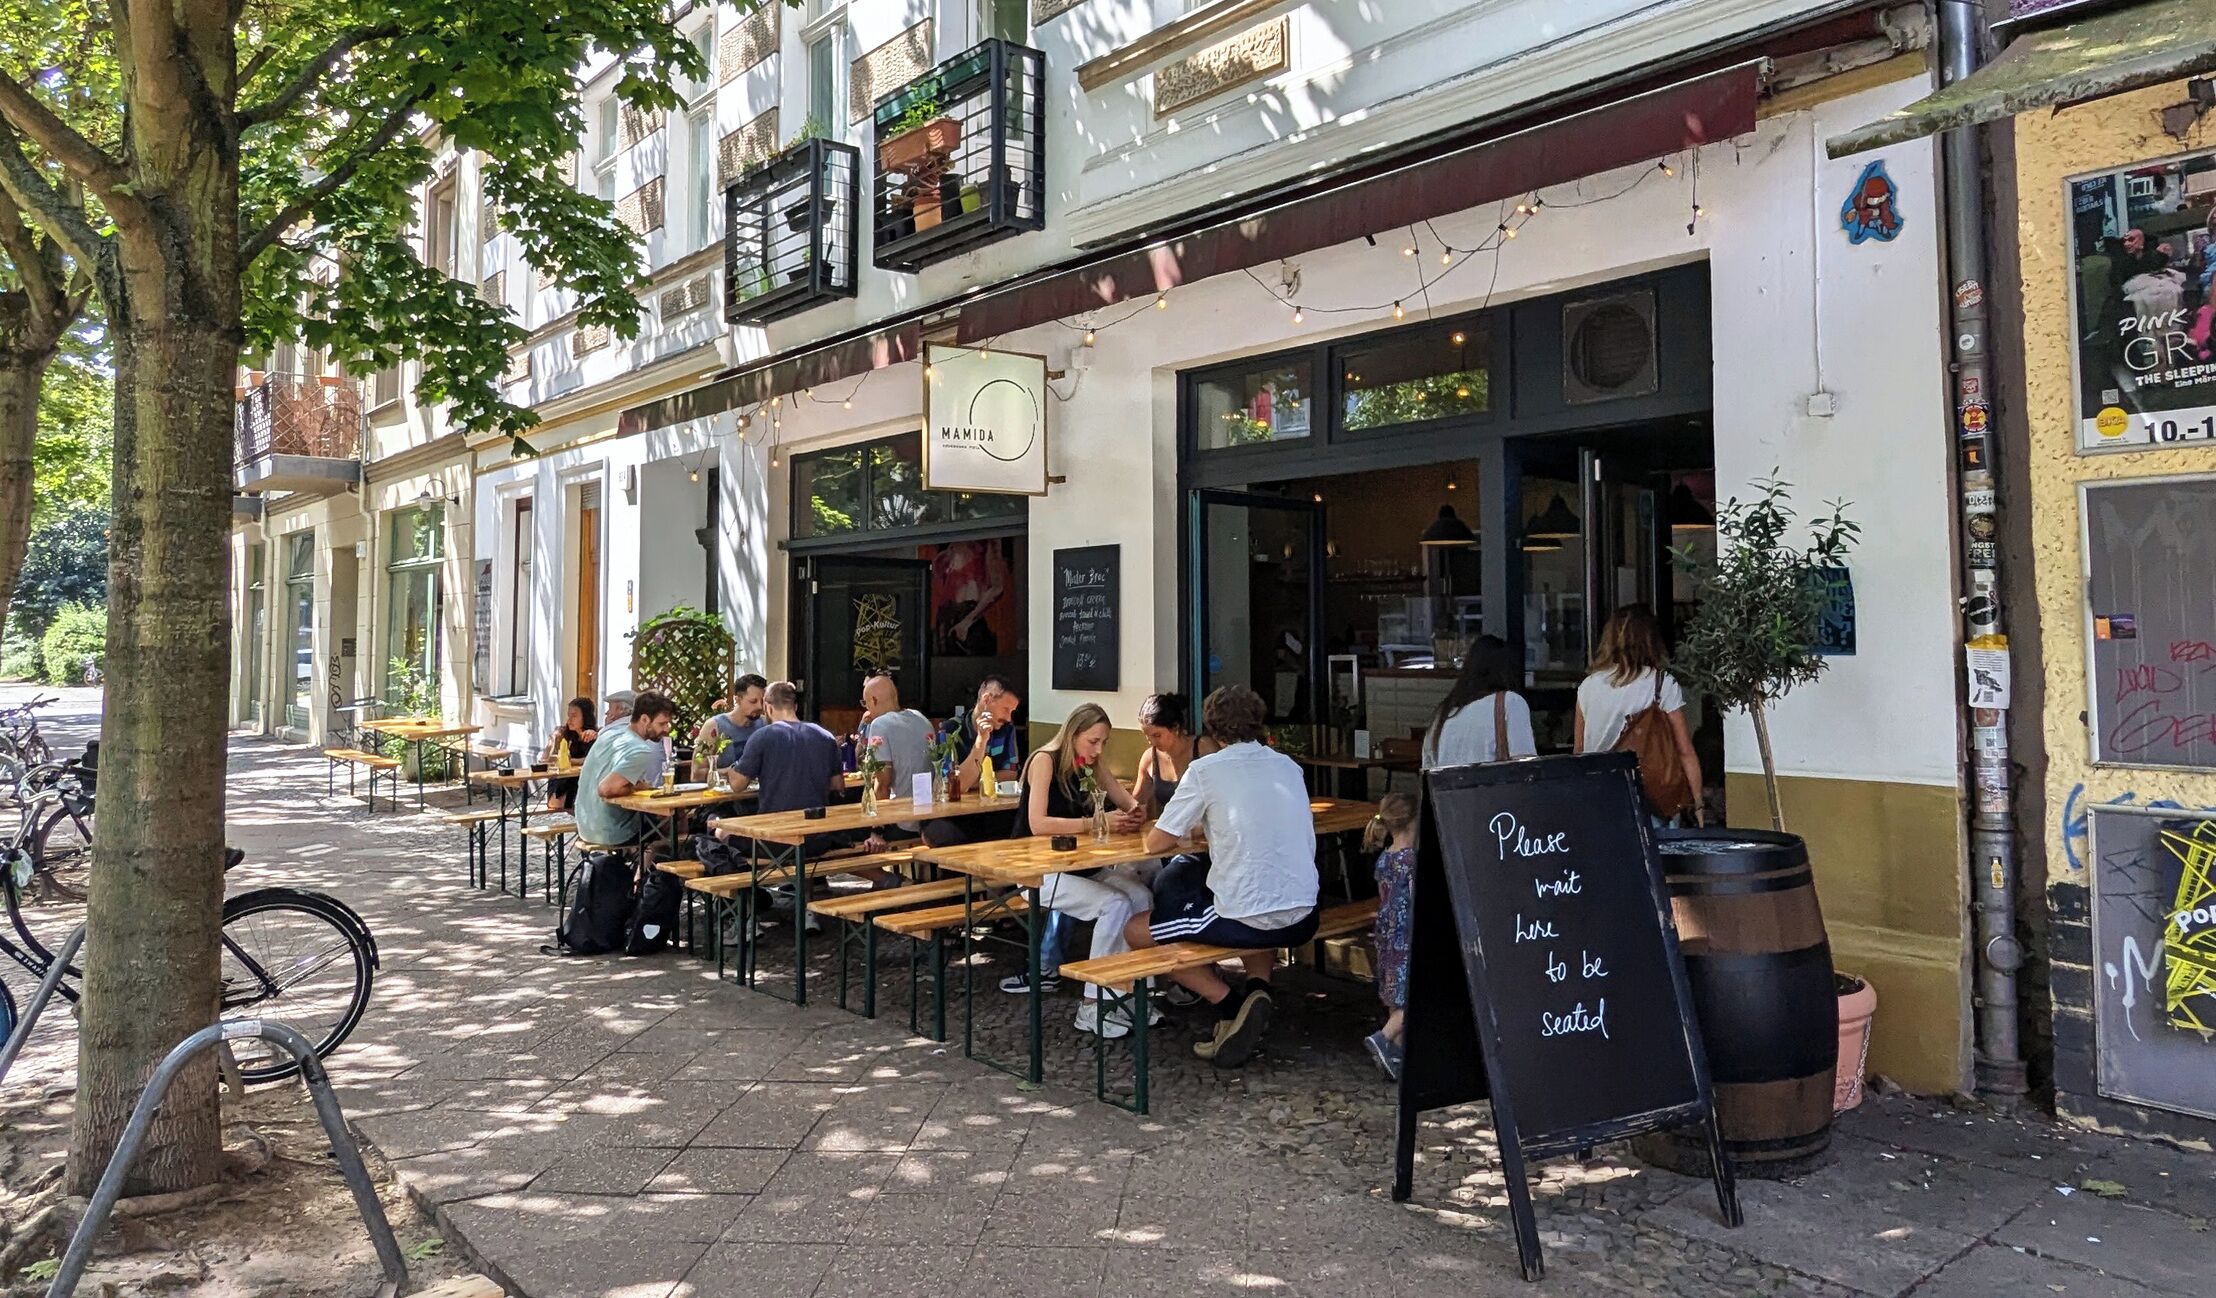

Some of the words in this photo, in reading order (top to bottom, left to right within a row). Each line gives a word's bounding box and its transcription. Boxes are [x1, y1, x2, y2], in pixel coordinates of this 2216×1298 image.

[2118, 308, 2188, 336] PINK
[2135, 372, 2161, 386] THE
[942, 427, 994, 442] MAMIDA
[1489, 812, 1570, 860] Please
[1535, 869, 1582, 898] wait
[1515, 913, 1560, 943] here
[1545, 951, 1567, 982] to
[1582, 950, 1609, 979] be
